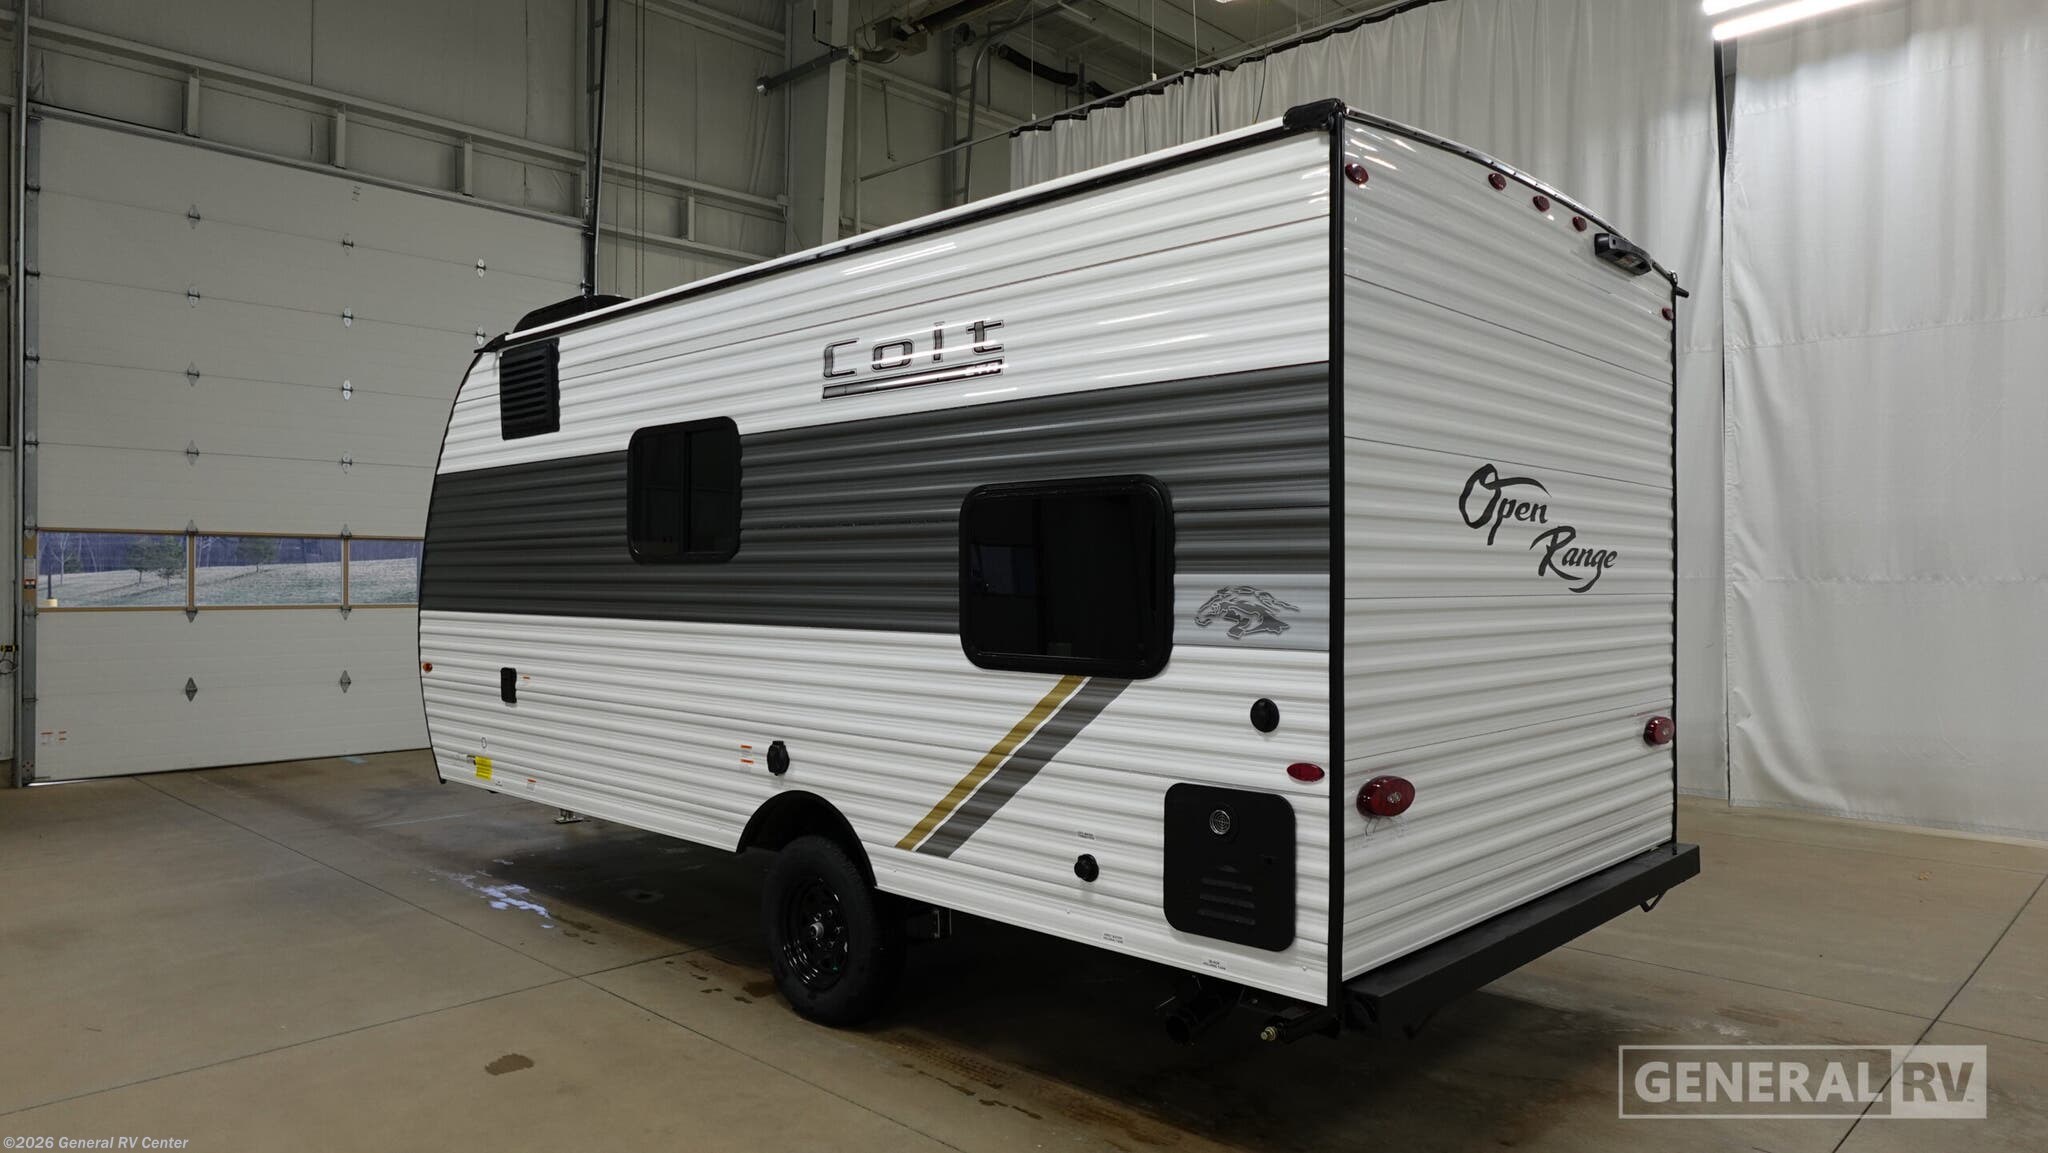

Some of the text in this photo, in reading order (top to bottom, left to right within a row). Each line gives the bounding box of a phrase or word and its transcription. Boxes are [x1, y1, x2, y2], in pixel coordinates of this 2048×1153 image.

[823, 319, 1004, 379] Colt
[1459, 463, 1552, 546] Open
[1529, 525, 1618, 593] Range
